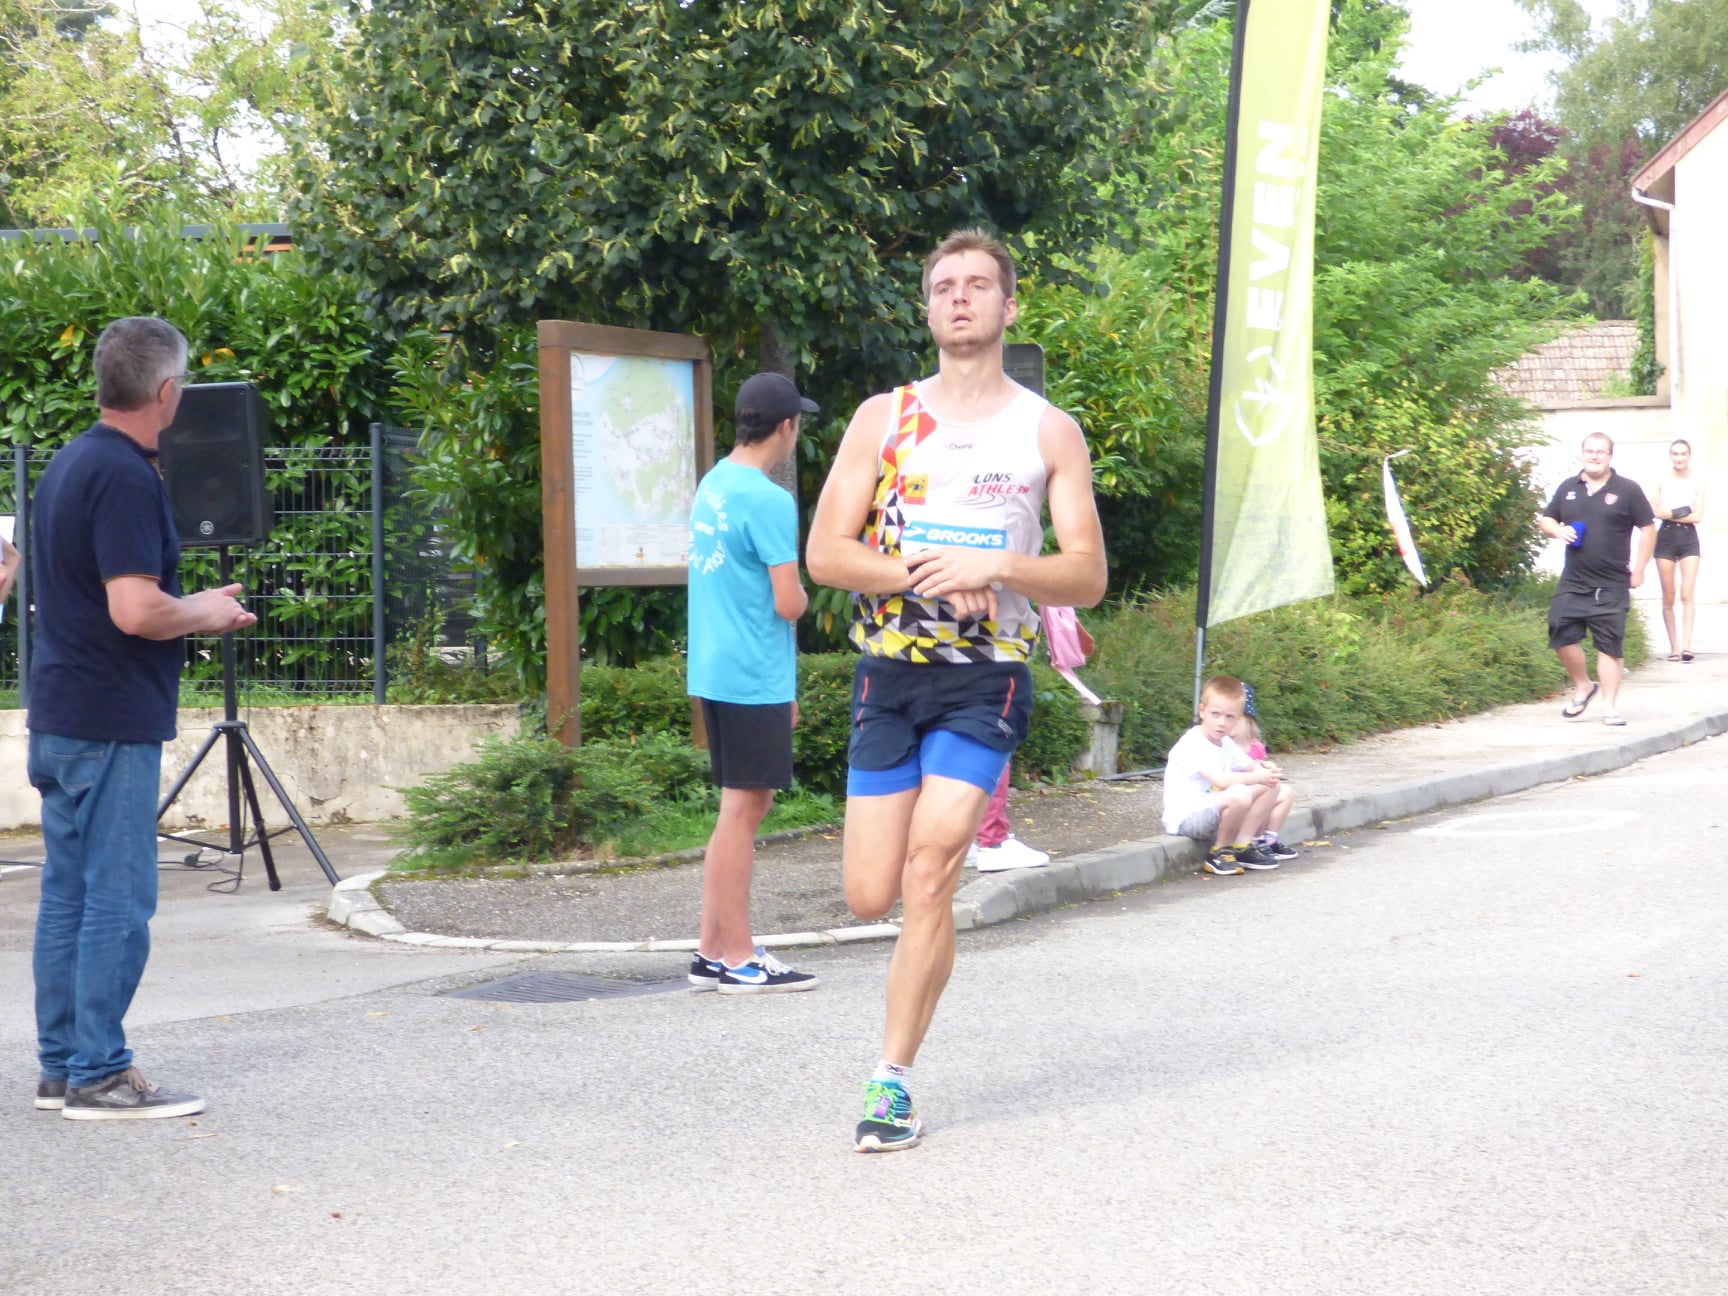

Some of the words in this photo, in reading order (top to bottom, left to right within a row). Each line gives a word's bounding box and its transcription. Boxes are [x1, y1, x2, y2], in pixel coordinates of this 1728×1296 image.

[1247, 119, 1308, 332] EVEN
[974, 473, 1012, 484] LONS
[969, 484, 1014, 496] ATHLE
[926, 529, 1003, 546] BROOKS
